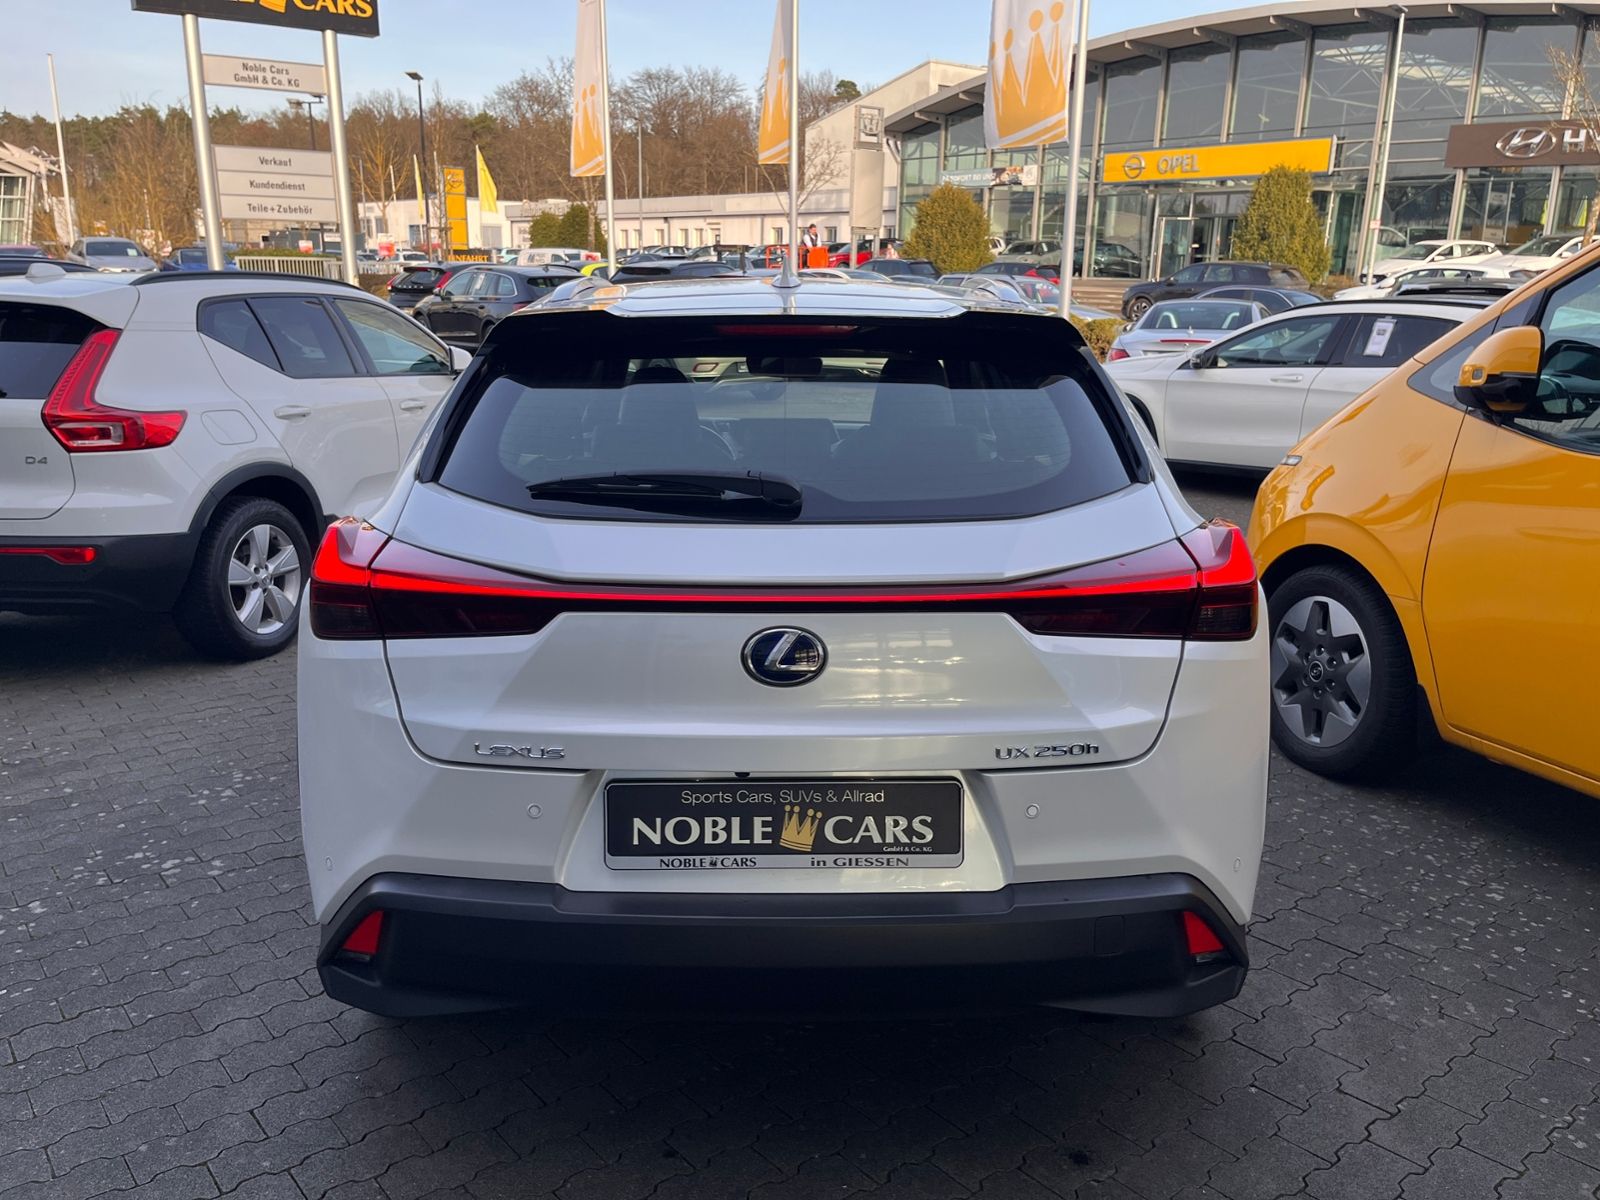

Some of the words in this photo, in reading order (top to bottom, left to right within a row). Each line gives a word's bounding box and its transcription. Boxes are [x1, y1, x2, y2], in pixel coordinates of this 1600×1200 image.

[242, 62, 267, 73] Noble
[269, 65, 290, 75] Cars
[234, 73, 259, 84] GmbH
[262, 75, 269, 85] &
[271, 76, 285, 86] Co.
[288, 79, 300, 88] KG
[258, 156, 292, 167] Verkauf
[1157, 154, 1200, 174] OPEL
[249, 180, 305, 191] Kundendienst
[25, 456, 48, 465] D4
[474, 743, 565, 760] LEXUS
[995, 747, 1030, 760] UX
[1033, 742, 1100, 758] 250h
[681, 790, 733, 806] Sports
[736, 790, 776, 805] Cars,
[779, 789, 822, 803] SUVs
[826, 789, 838, 803] &
[841, 789, 885, 803] Allrad
[632, 816, 773, 845] NOBLE
[824, 815, 934, 844] CARS
[659, 858, 706, 868] NOBLE
[720, 857, 757, 867] CARS
[810, 857, 827, 867] in
[833, 857, 909, 867] GIESSEN
